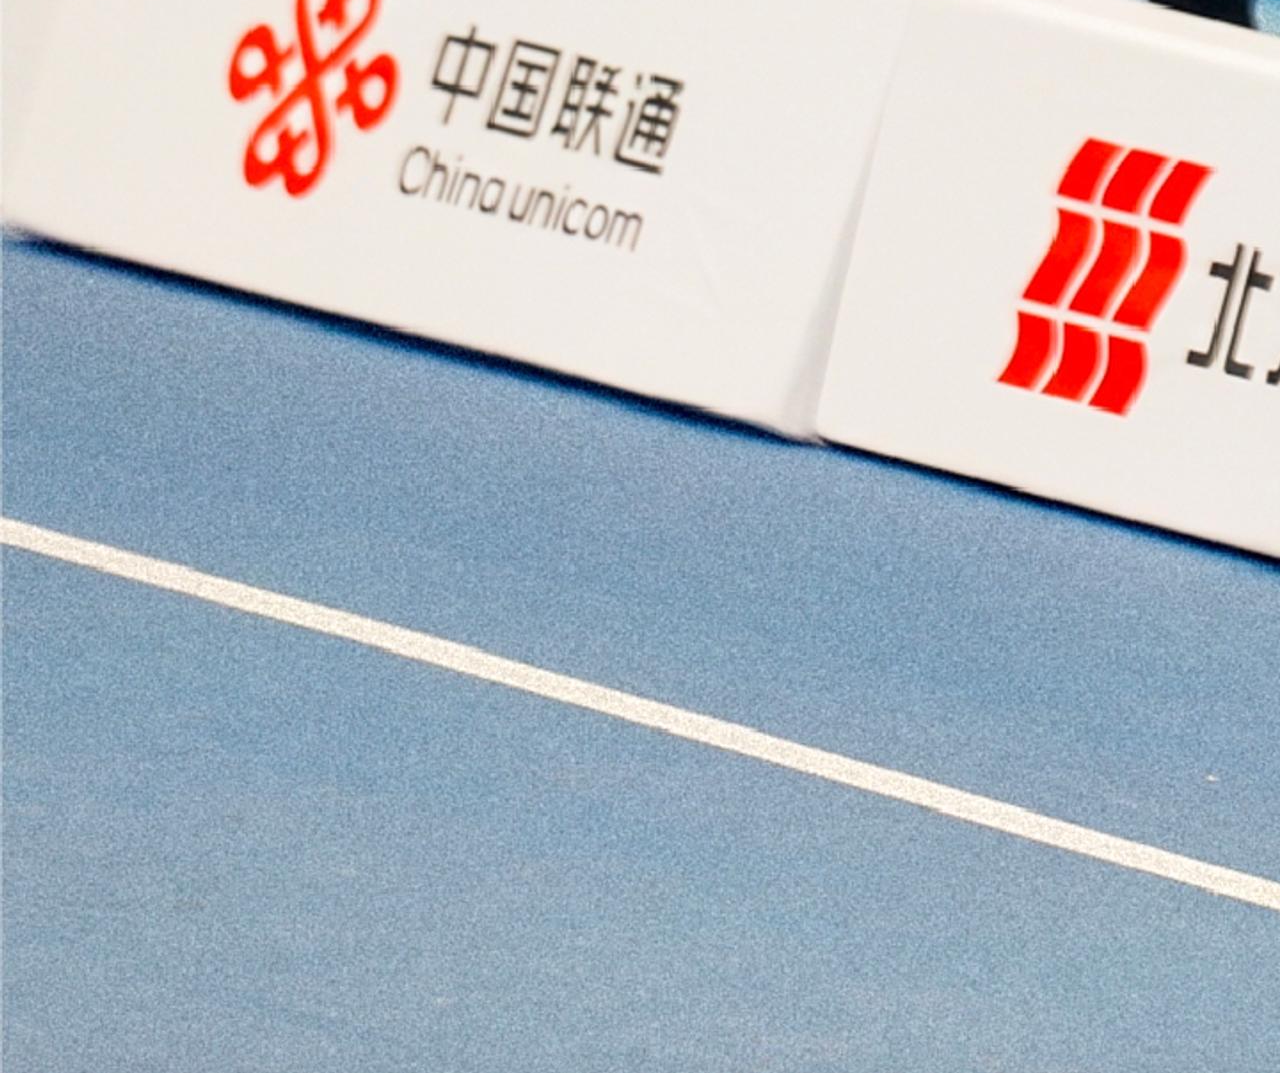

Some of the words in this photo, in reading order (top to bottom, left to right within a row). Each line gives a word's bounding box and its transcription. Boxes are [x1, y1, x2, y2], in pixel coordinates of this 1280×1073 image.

[431, 26, 684, 175] 中国联通
[399, 145, 506, 215] China
[507, 182, 644, 252] unicom
